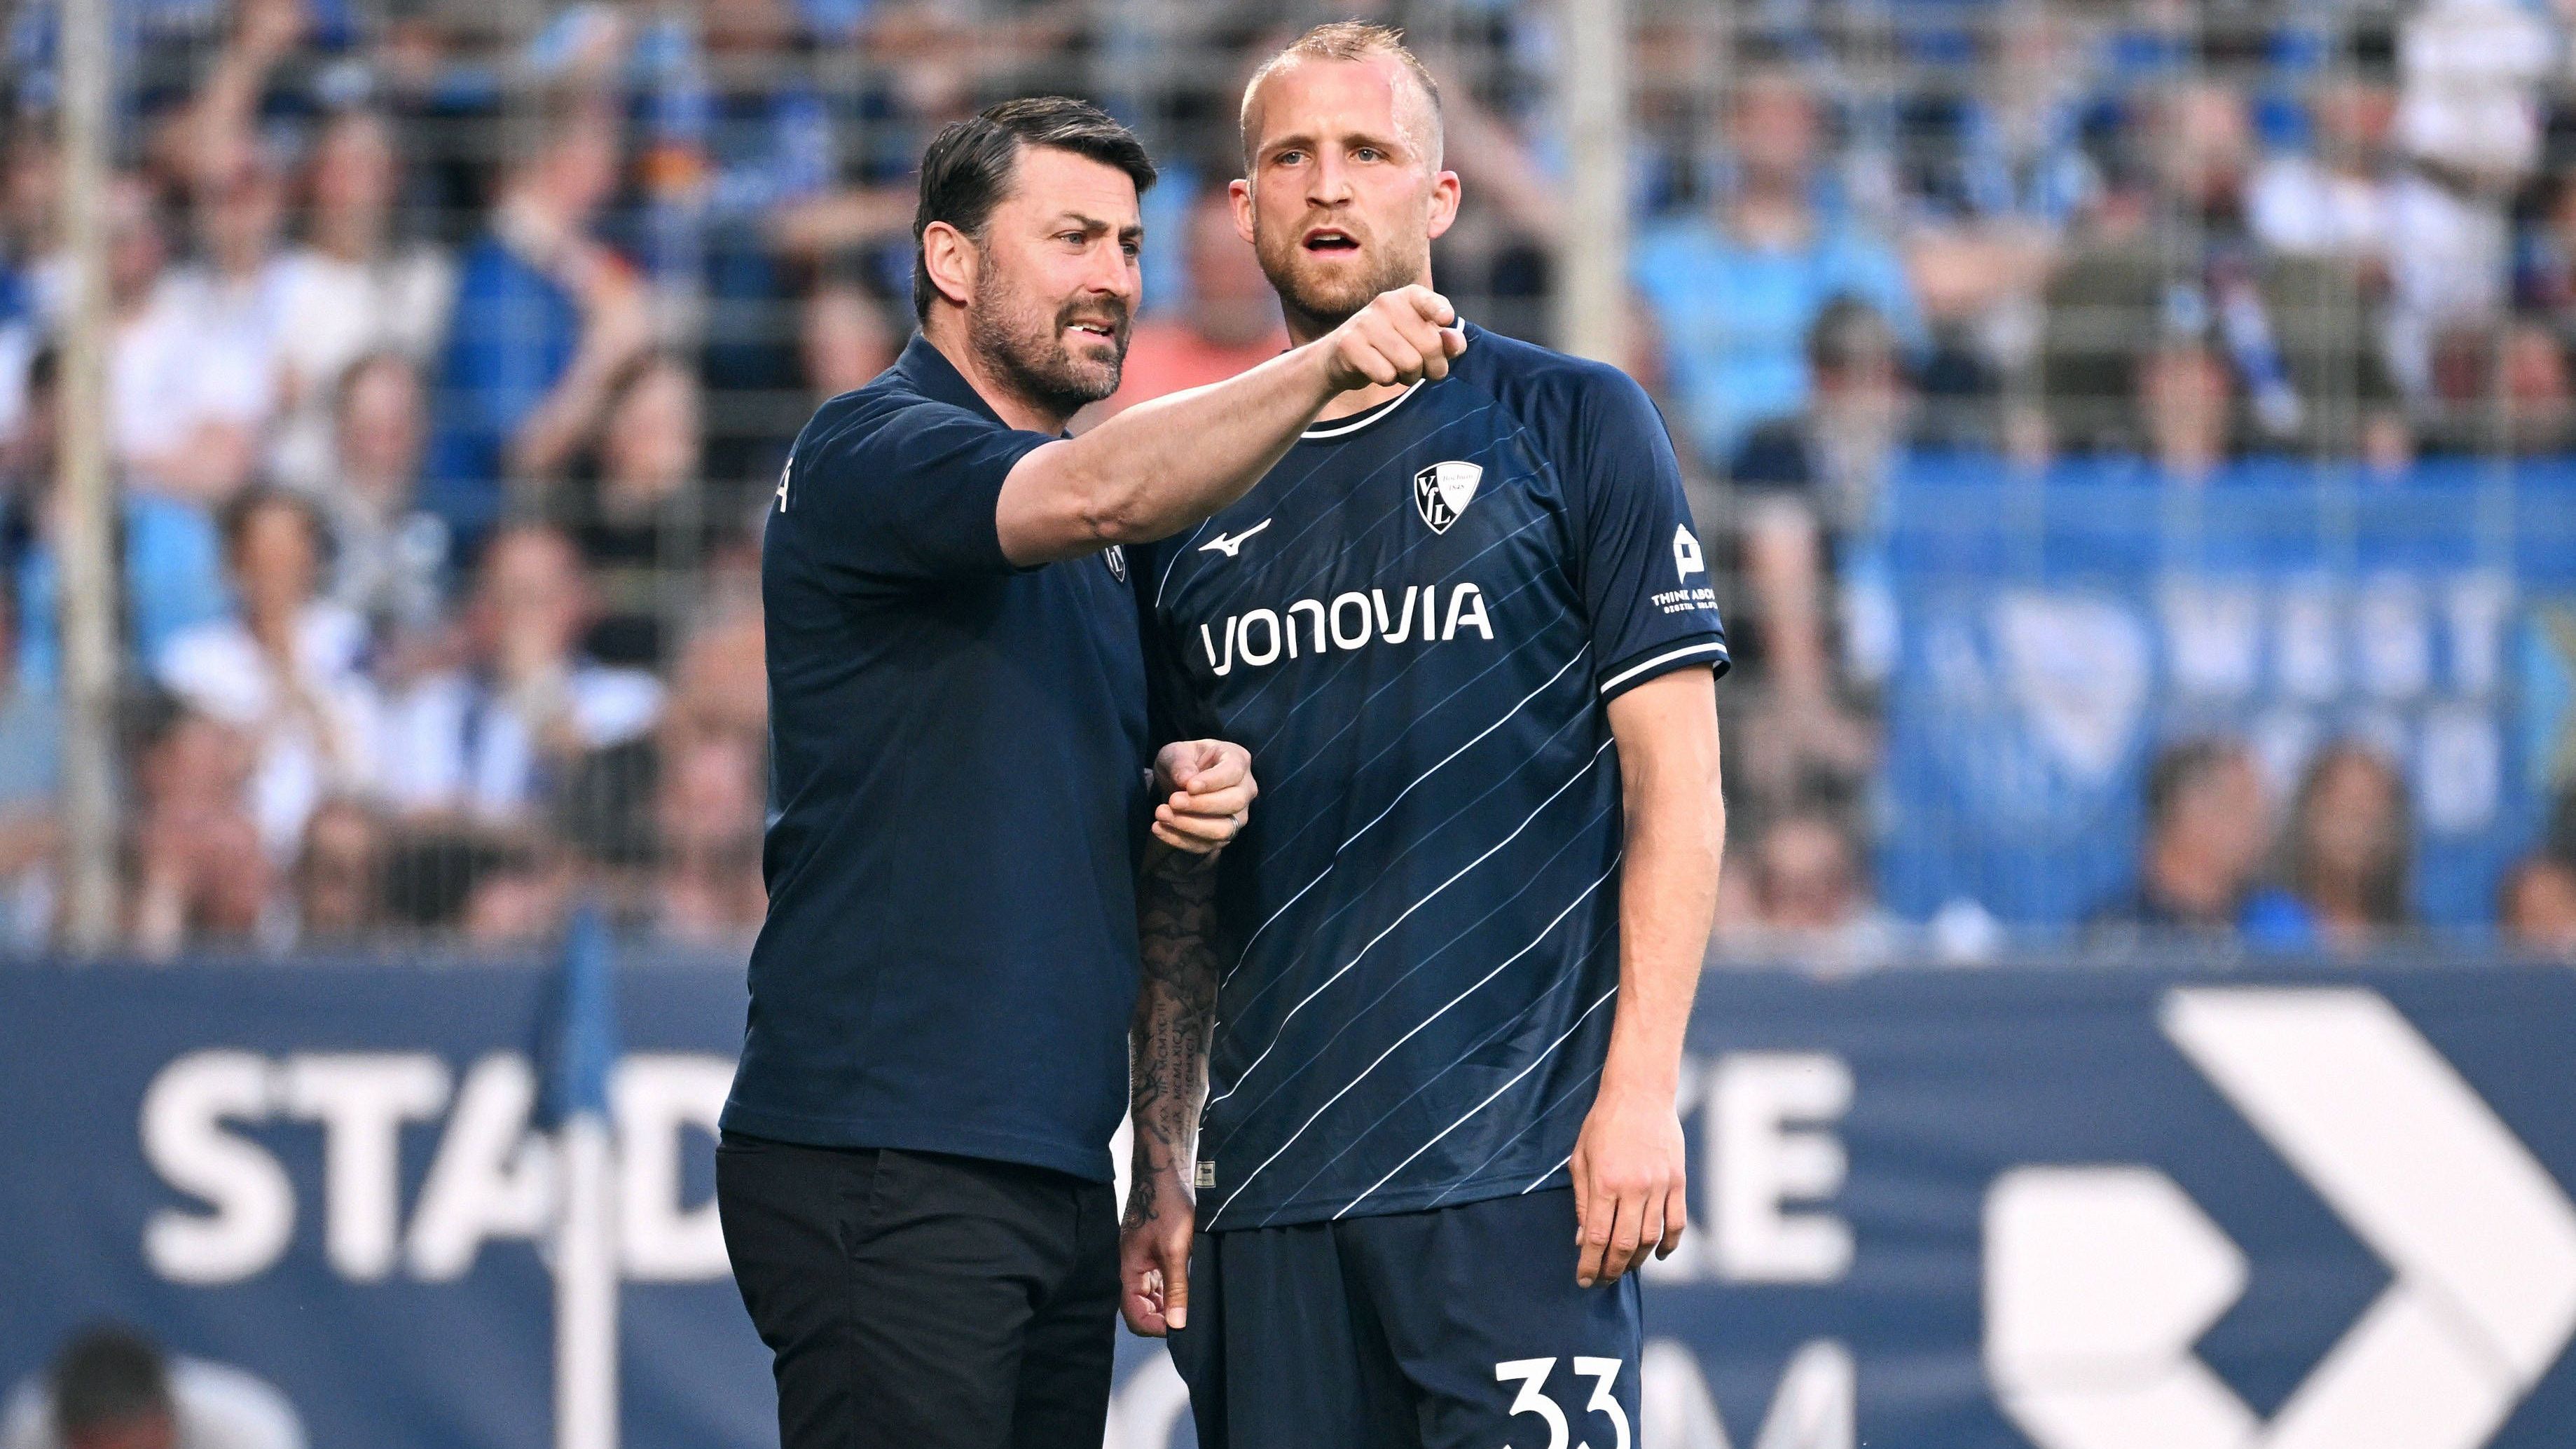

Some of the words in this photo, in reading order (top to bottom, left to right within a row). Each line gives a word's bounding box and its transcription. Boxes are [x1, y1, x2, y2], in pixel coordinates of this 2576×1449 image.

[1418, 475, 1451, 524] VfL
[1651, 589, 1690, 606] THINK
[1664, 603, 1695, 614] DIGITAL
[1496, 1356, 1631, 1449] 33
